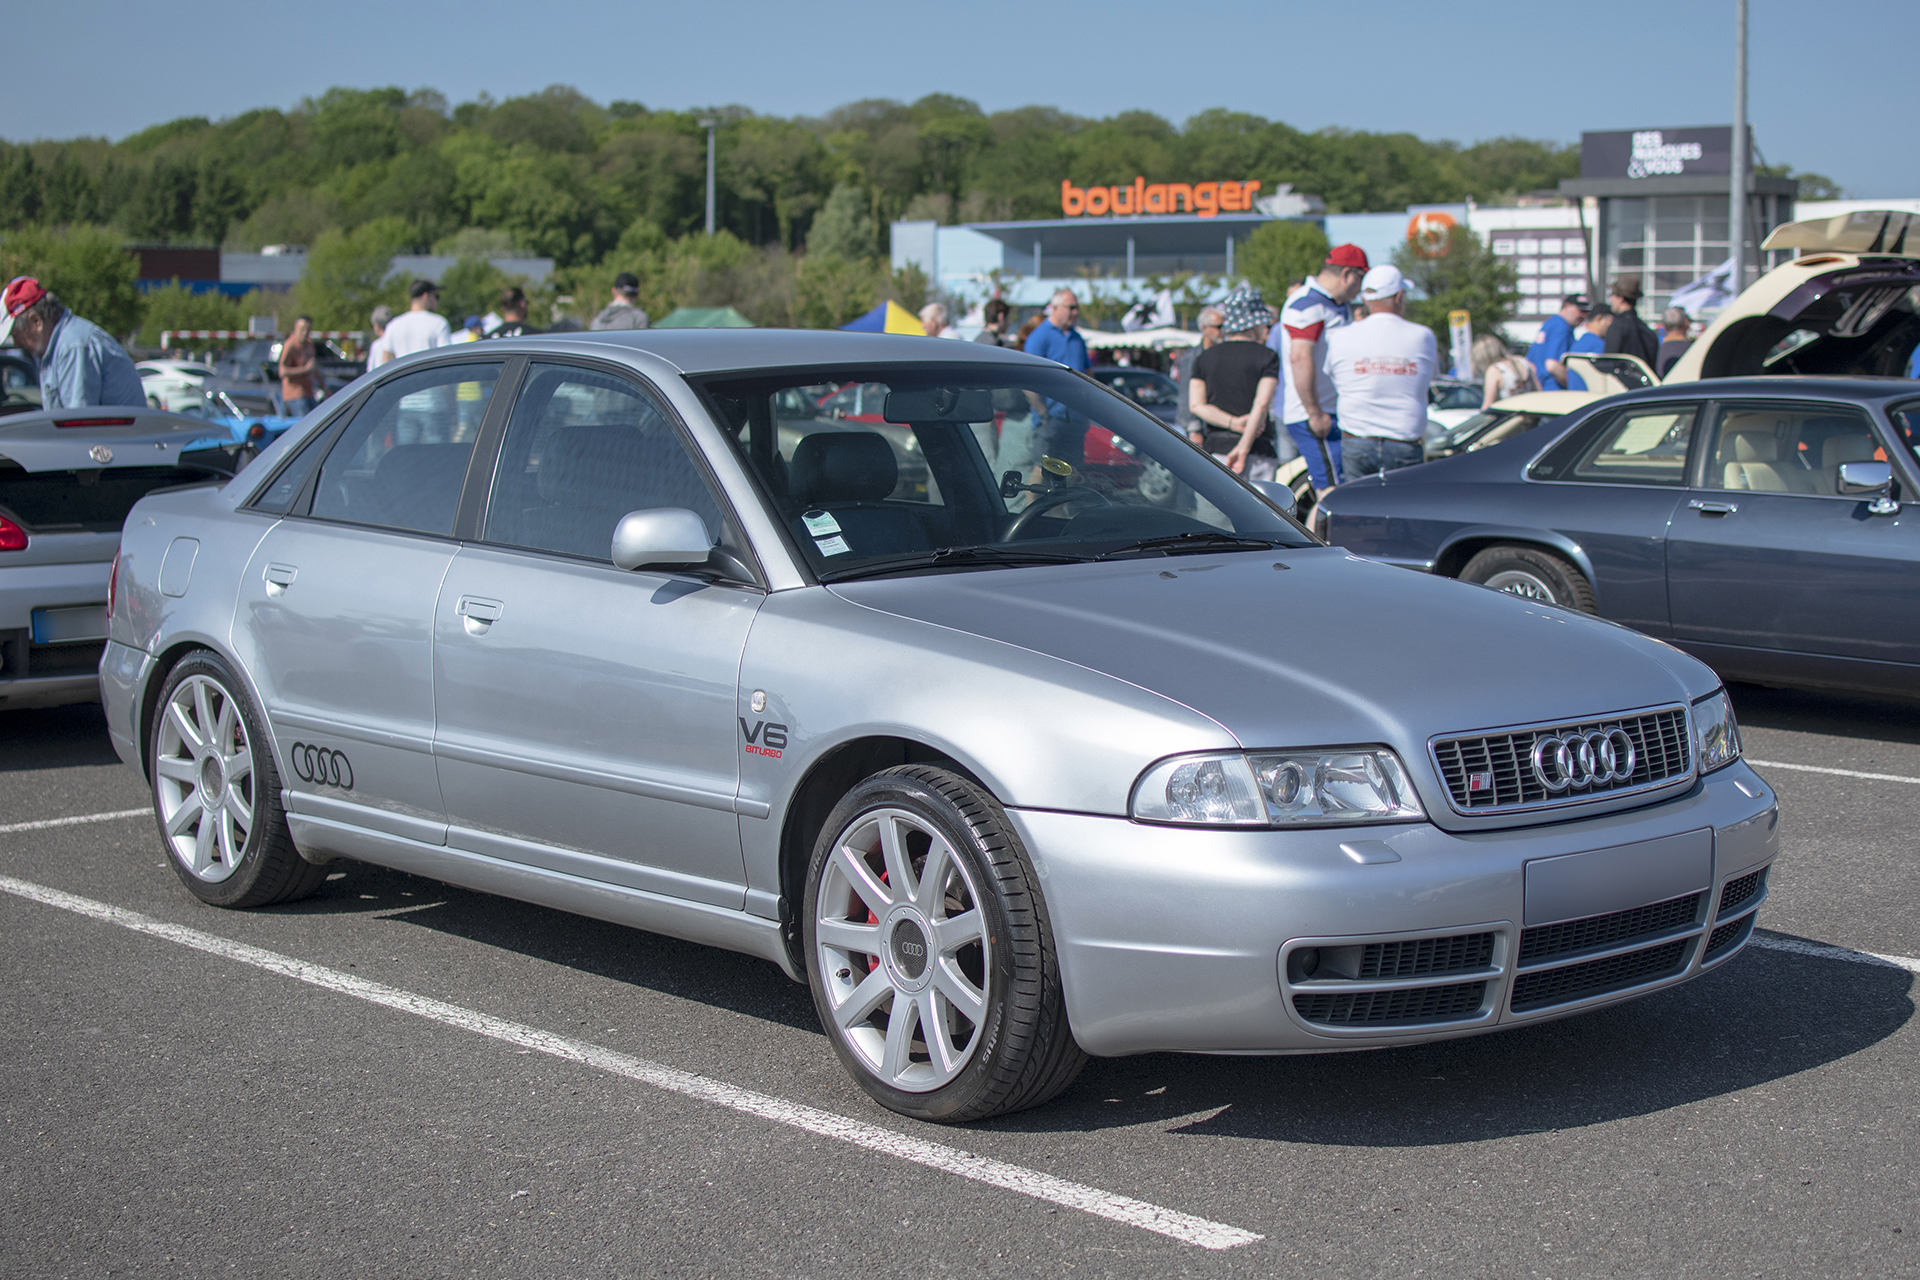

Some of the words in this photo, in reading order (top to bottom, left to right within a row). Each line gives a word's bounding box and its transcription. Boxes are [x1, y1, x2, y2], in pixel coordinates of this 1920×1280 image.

[1061, 175, 1261, 219] boulanger
[738, 716, 788, 750] V6
[745, 744, 783, 759] BITURBO
